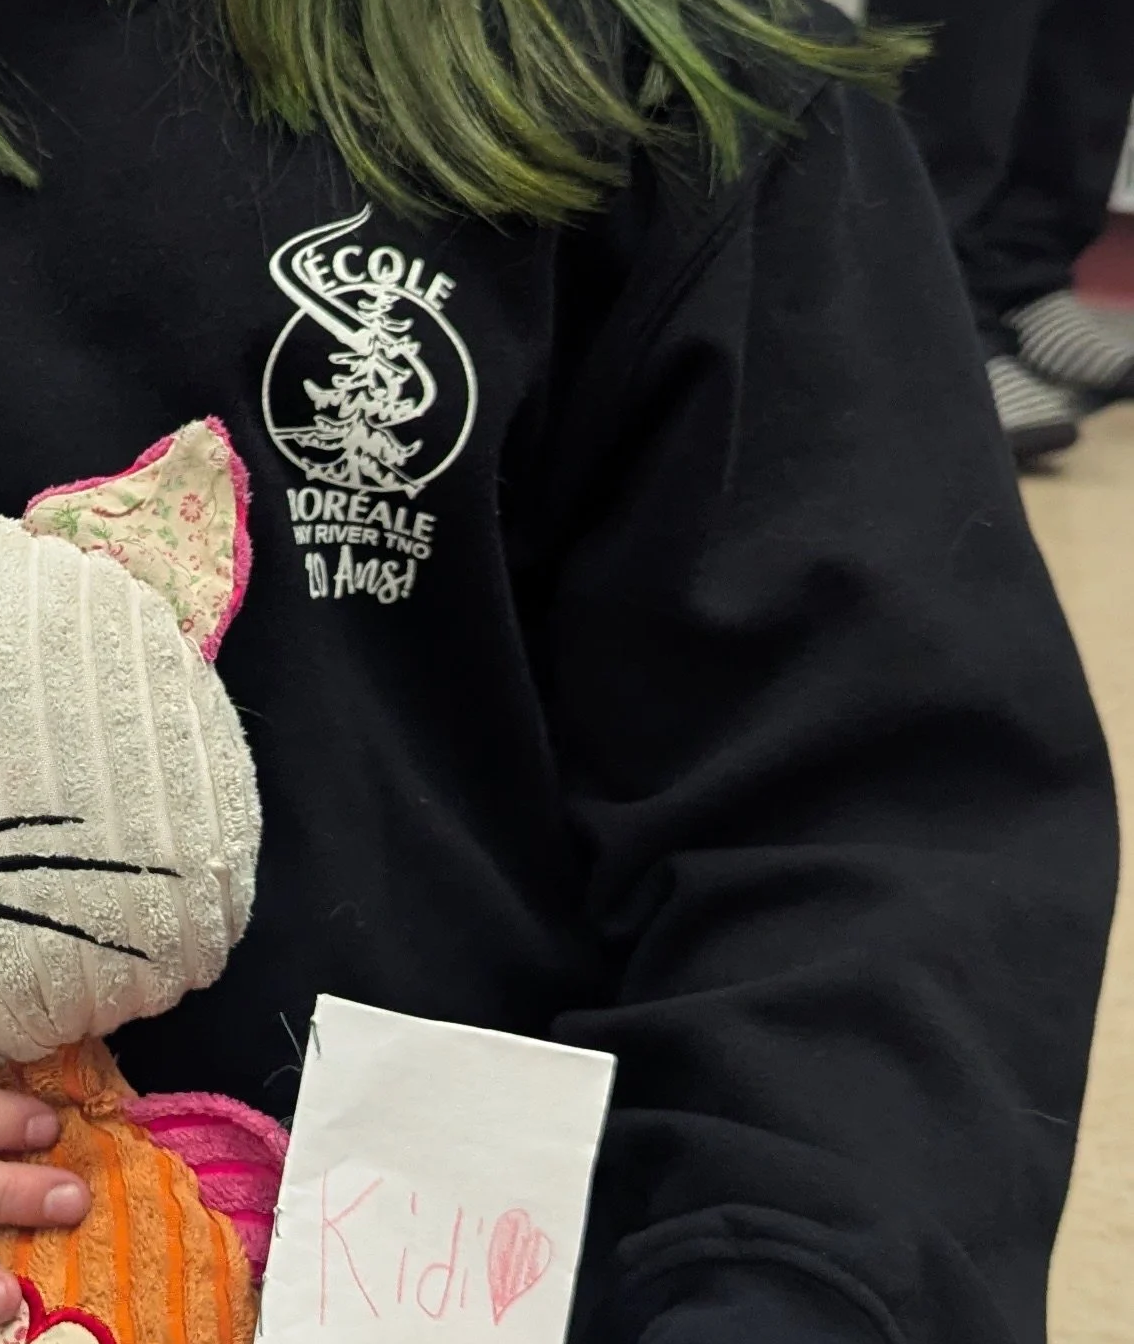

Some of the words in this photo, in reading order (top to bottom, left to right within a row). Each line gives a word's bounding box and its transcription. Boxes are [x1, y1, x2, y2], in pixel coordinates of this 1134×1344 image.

[315, 524, 380, 546] RIVER
[383, 531, 433, 560] TNO
[320, 1168, 484, 1326] Kidi
